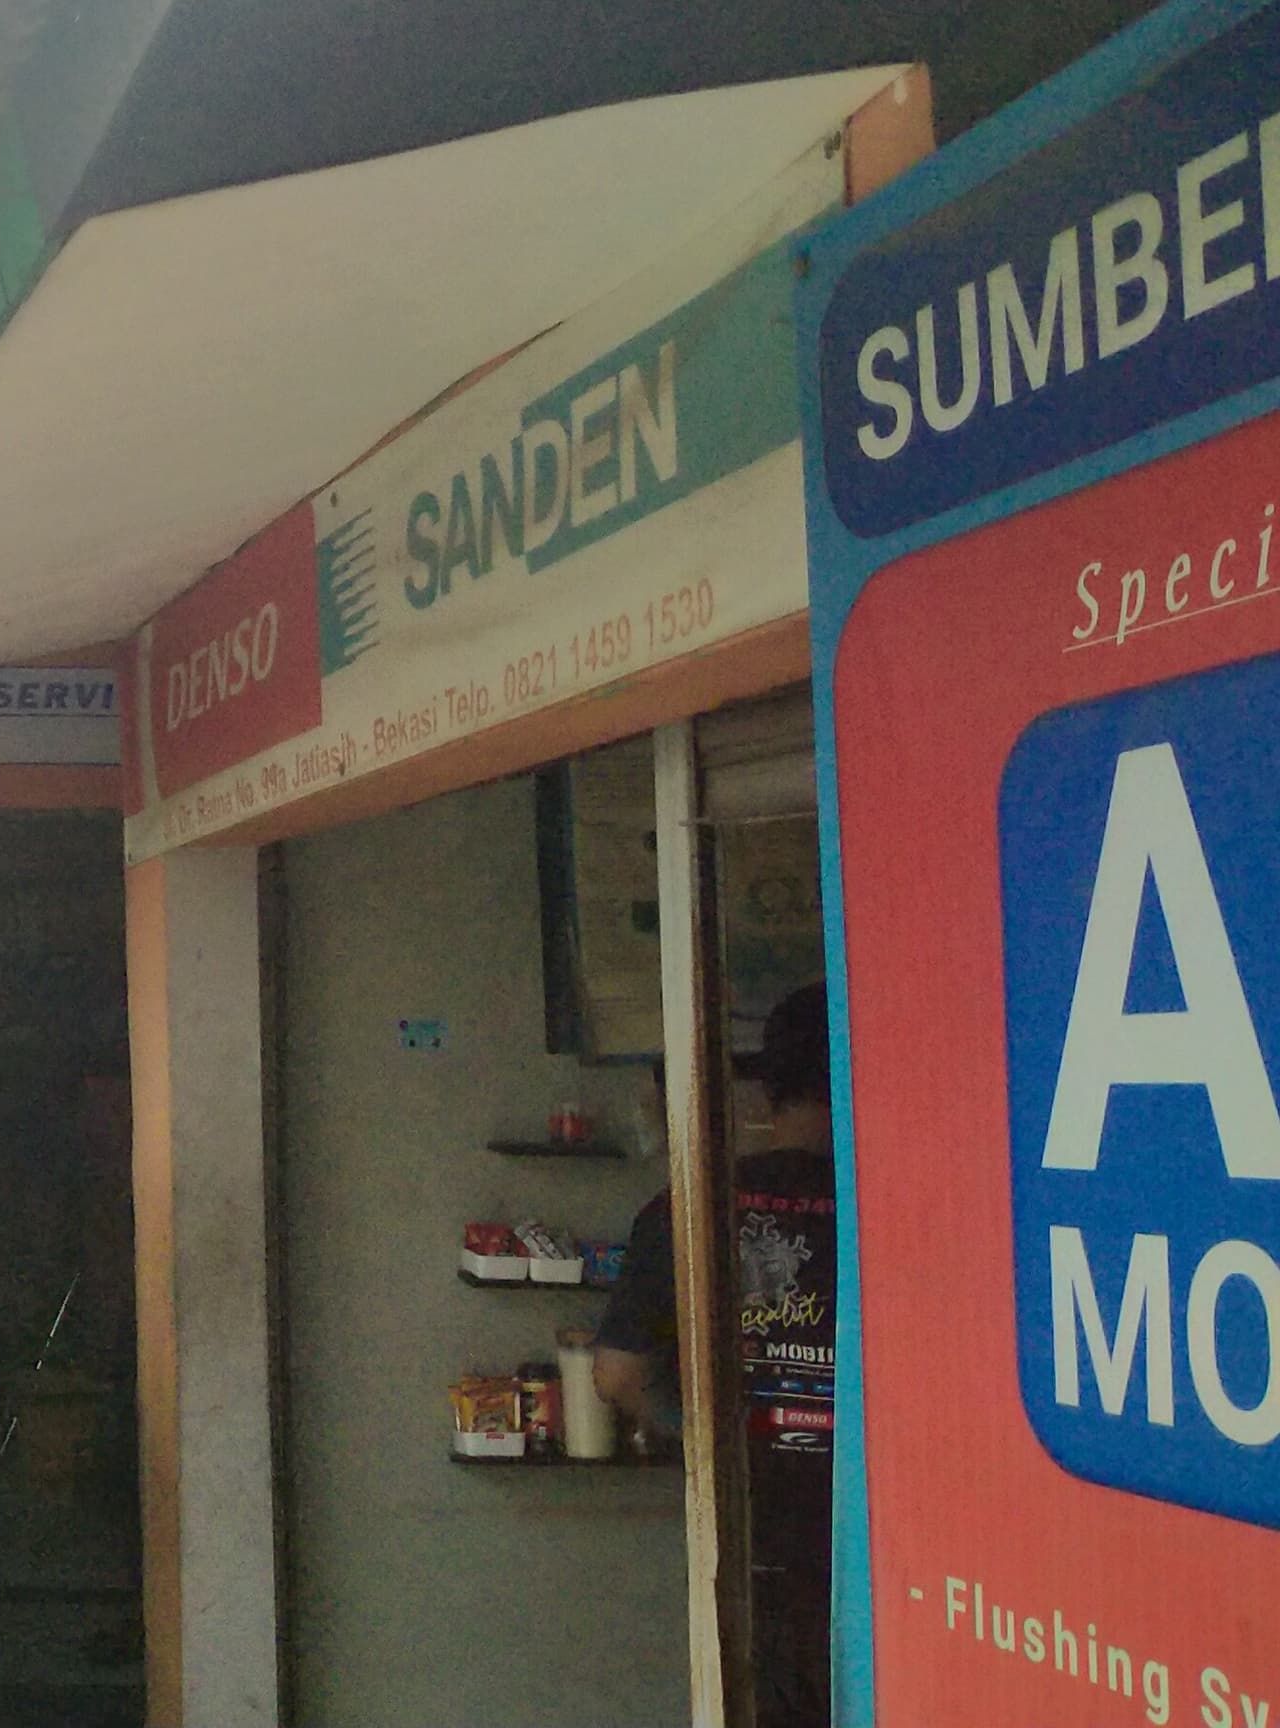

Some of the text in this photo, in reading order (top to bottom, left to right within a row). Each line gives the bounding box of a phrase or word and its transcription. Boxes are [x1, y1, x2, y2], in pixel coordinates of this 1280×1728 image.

[402, 340, 678, 611] SANDEN
[1072, 503, 1276, 645] Speci
[164, 602, 281, 733] DENSO
[373, 696, 438, 757] Bekasi
[445, 680, 495, 729] Telp.
[503, 644, 557, 706] 0821
[570, 613, 631, 680] 1459
[644, 577, 714, 647] 1530
[1041, 741, 1280, 1181] A
[1049, 1224, 1280, 1446] MO
[946, 1576, 1170, 1726] Flushing
